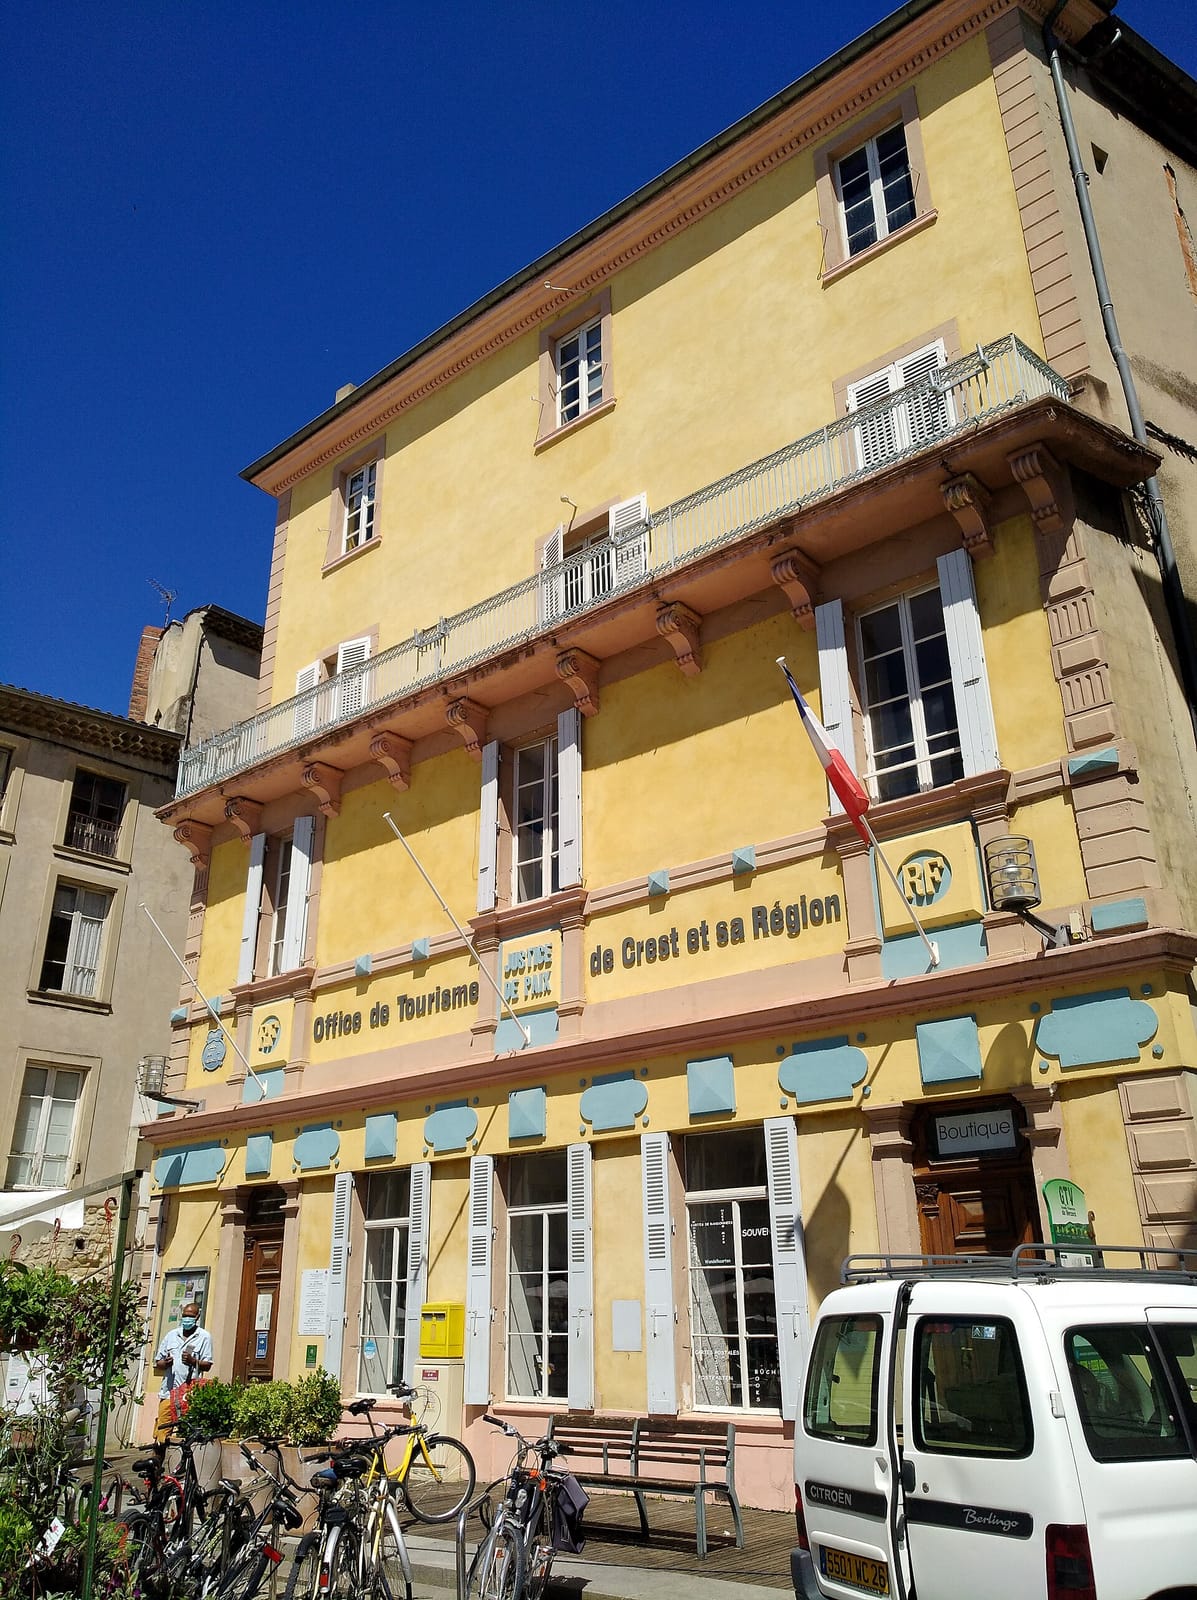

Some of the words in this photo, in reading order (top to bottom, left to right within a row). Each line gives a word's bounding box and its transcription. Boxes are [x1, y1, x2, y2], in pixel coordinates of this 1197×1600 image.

[902, 857, 944, 900] RF
[590, 945, 614, 977] de
[621, 927, 680, 969] Crest
[686, 920, 710, 954] et
[715, 917, 745, 949] sa
[752, 893, 841, 939] Région
[504, 943, 553, 974] JUSTICE
[504, 979, 519, 1001] DE
[524, 971, 552, 999] PAIX
[313, 1010, 362, 1043] Office
[369, 1001, 390, 1030] de
[397, 981, 480, 1022] Tourisme
[939, 1121, 1011, 1140] Boutique
[810, 1484, 852, 1506] CITROËN
[963, 1508, 1019, 1531] Berlingo
[827, 1551, 853, 1579] 5501
[871, 1564, 886, 1588] 26
